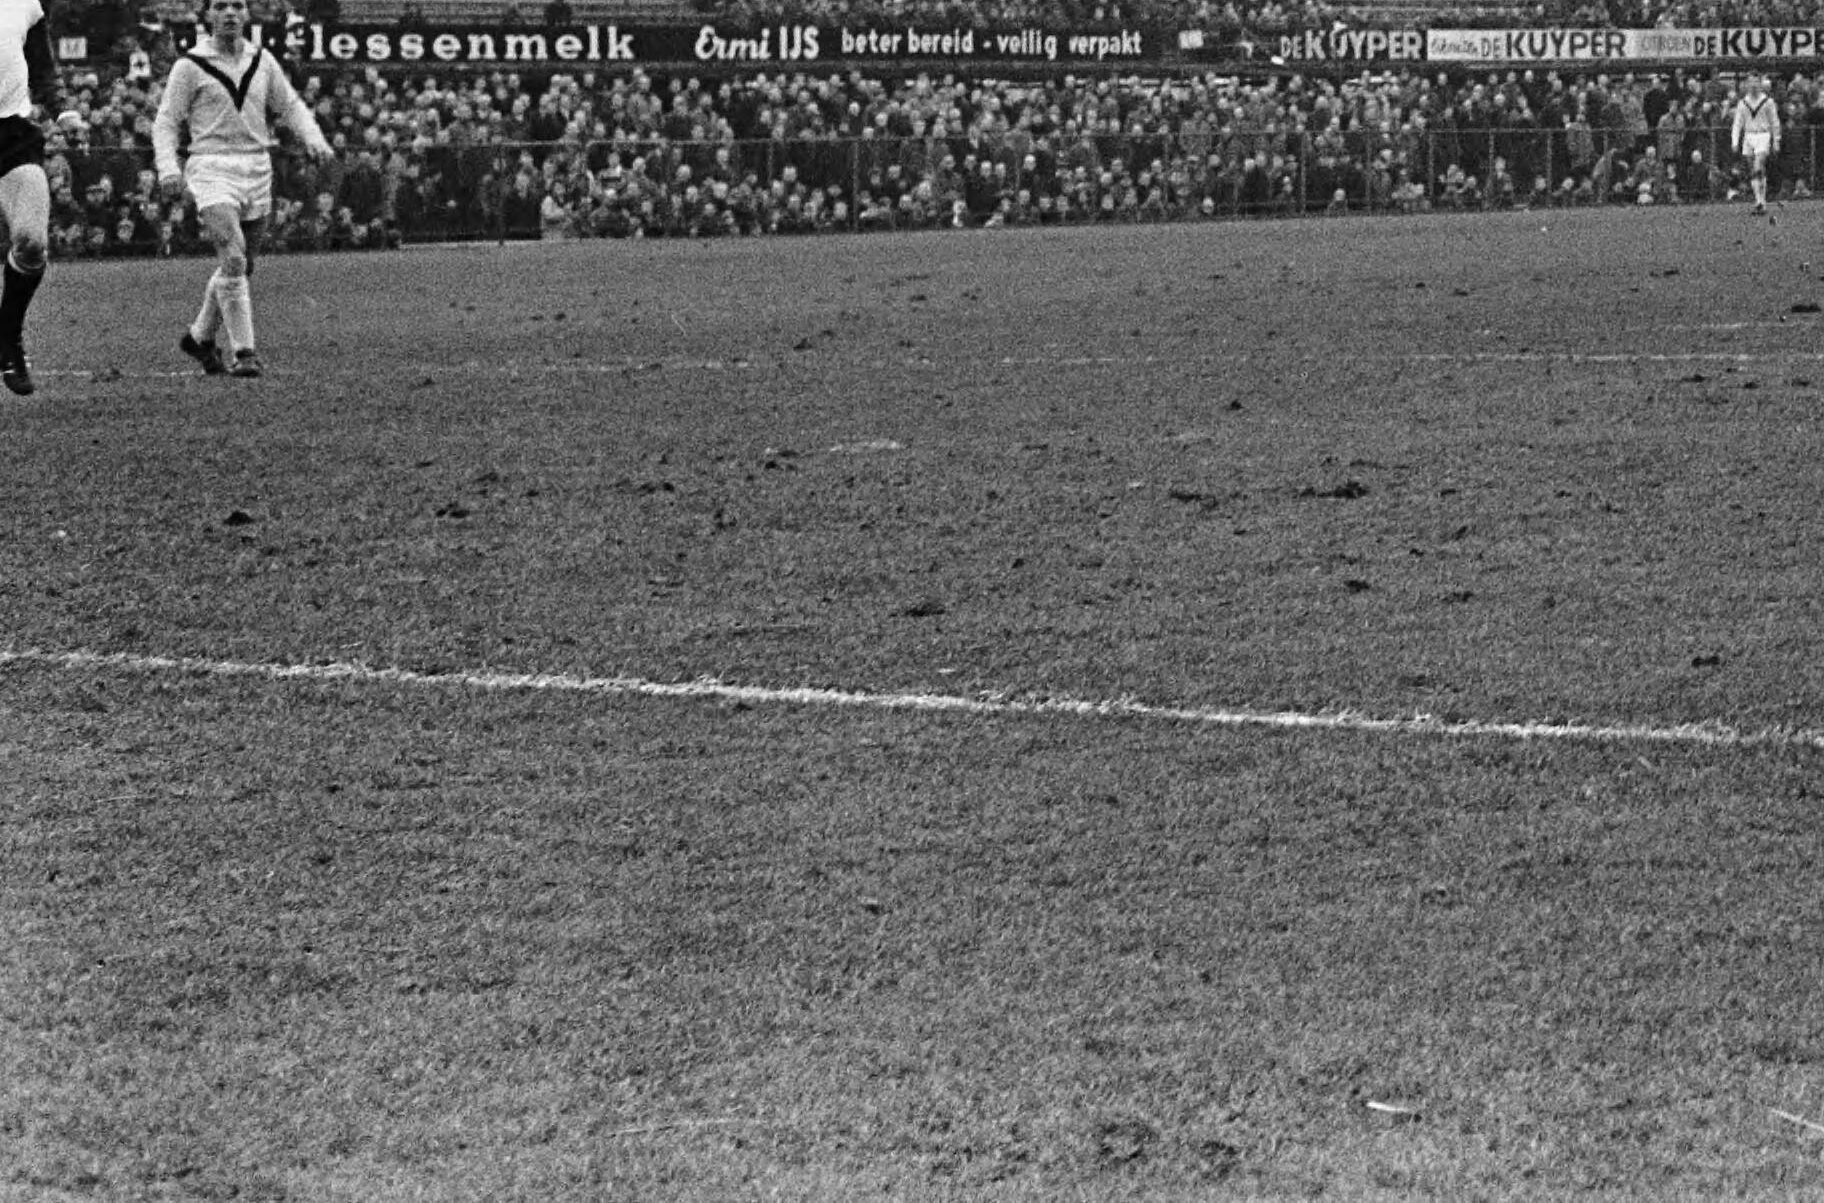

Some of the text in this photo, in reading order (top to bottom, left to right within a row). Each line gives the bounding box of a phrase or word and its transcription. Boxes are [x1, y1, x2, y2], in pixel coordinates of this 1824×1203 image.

[841, 26, 901, 54] beter
[908, 27, 974, 55] bereid
[1069, 29, 1142, 60] verpakt
[1279, 34, 1302, 58] DE
[1304, 29, 1422, 60] KUYPER
[1505, 31, 1626, 58] KUYPER
[1694, 35, 1717, 57] DE
